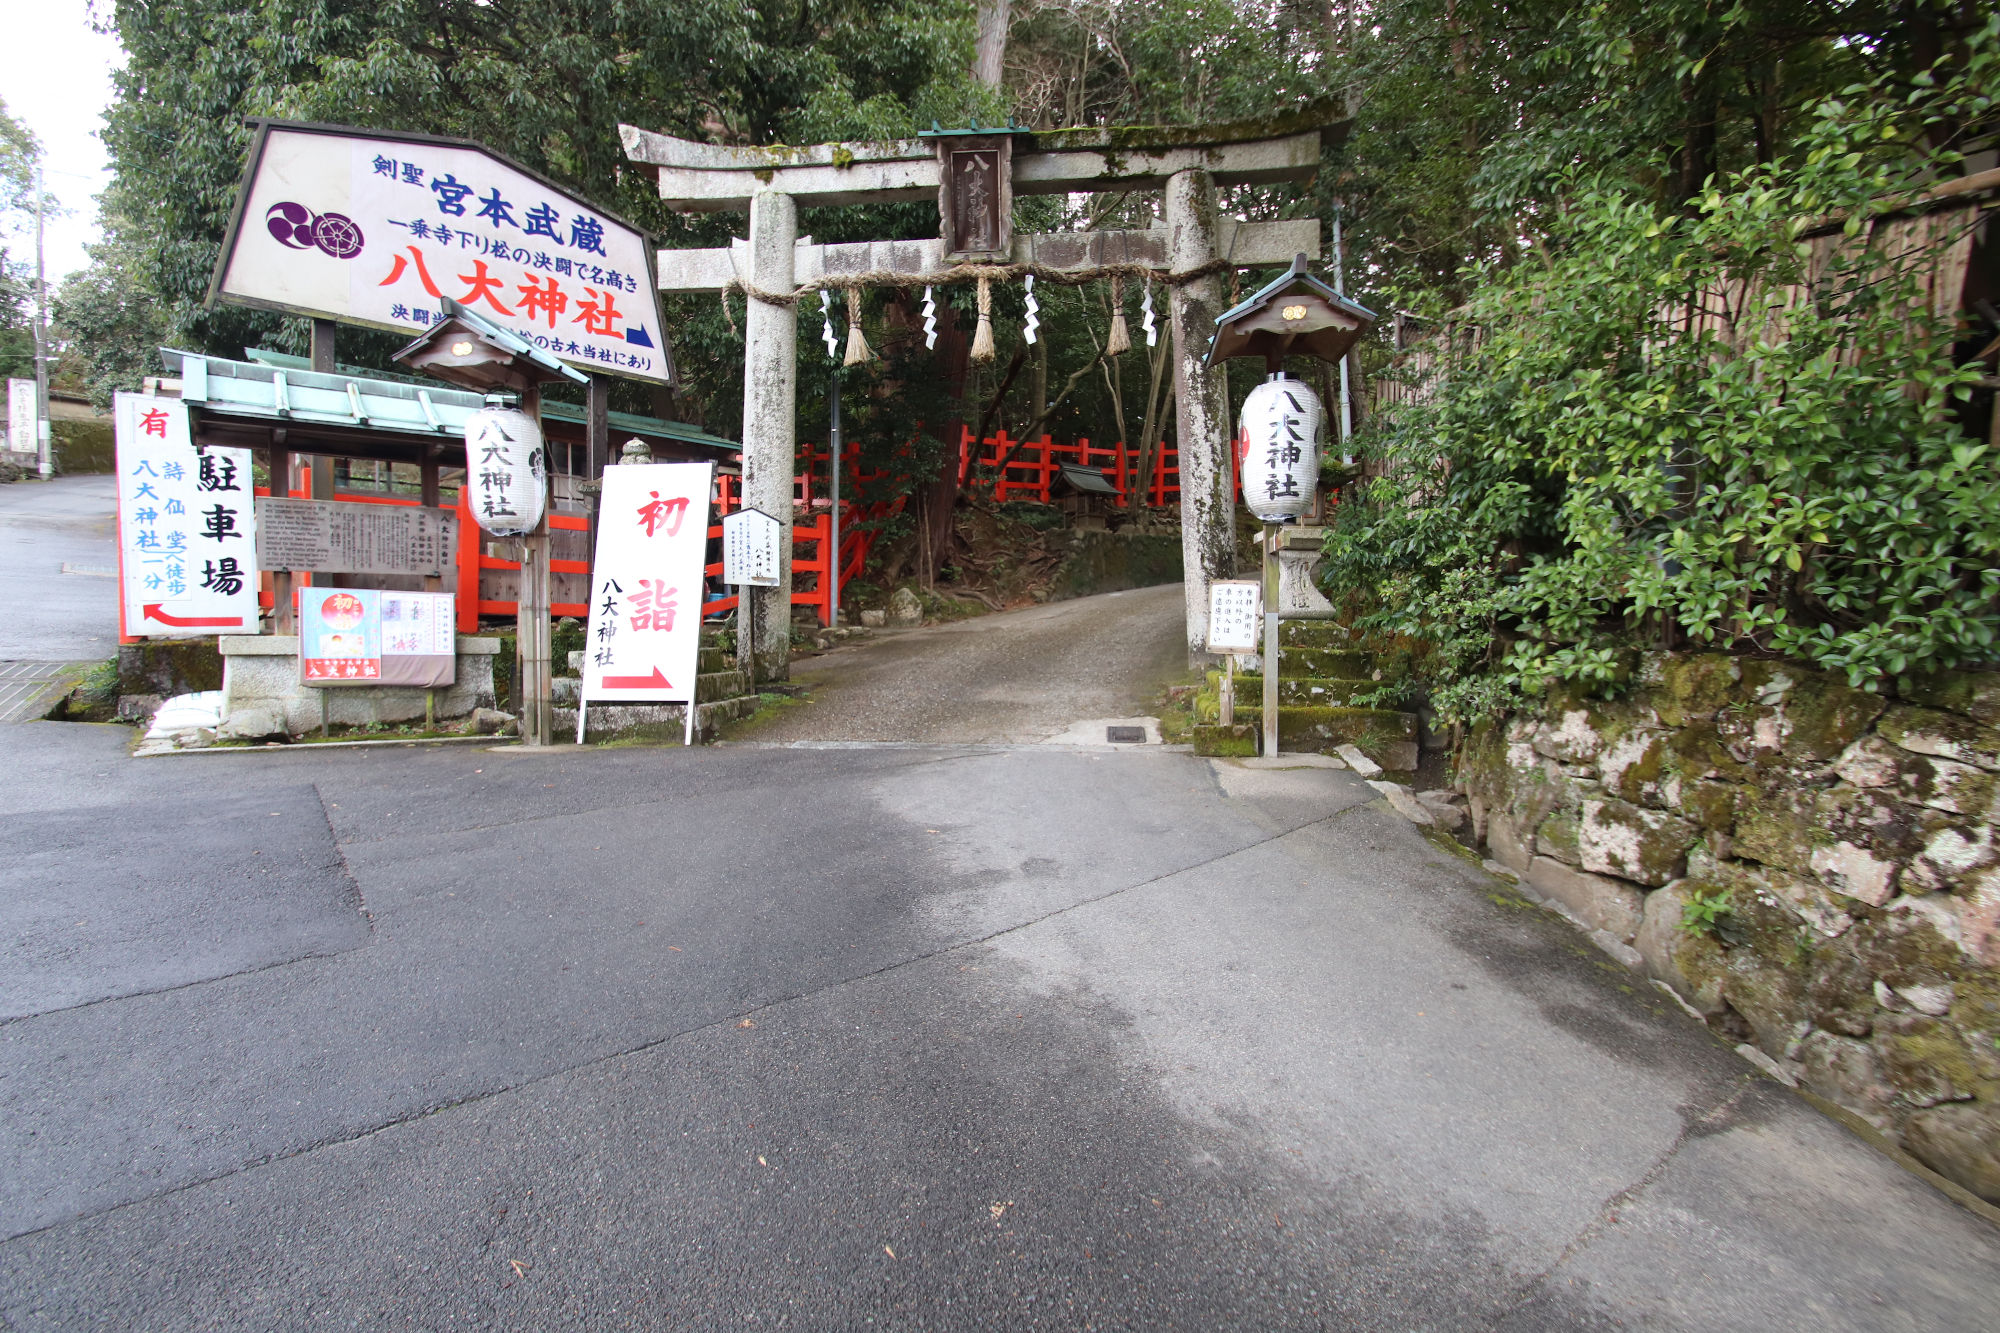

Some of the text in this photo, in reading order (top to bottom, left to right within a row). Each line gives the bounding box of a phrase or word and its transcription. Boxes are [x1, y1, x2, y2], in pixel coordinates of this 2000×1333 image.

[371, 153, 608, 257] 剣聖 宮本武蔵
[378, 245, 626, 340] 八大神社
[387, 218, 638, 293] 一乗寺下り松の決闘で名高き
[139, 407, 170, 438] 有
[1264, 389, 1306, 501] 八大神社
[132, 460, 161, 548] 八大神社
[162, 461, 187, 549] 詩仙堂
[478, 418, 517, 518] 八大神社
[197, 454, 245, 597] 駐車場
[627, 491, 690, 632] 初詣
[1213, 589, 1223, 642] ご遠慮下さい
[1235, 588, 1243, 624] 方以外の
[309, 666, 376, 676] 八大神社
